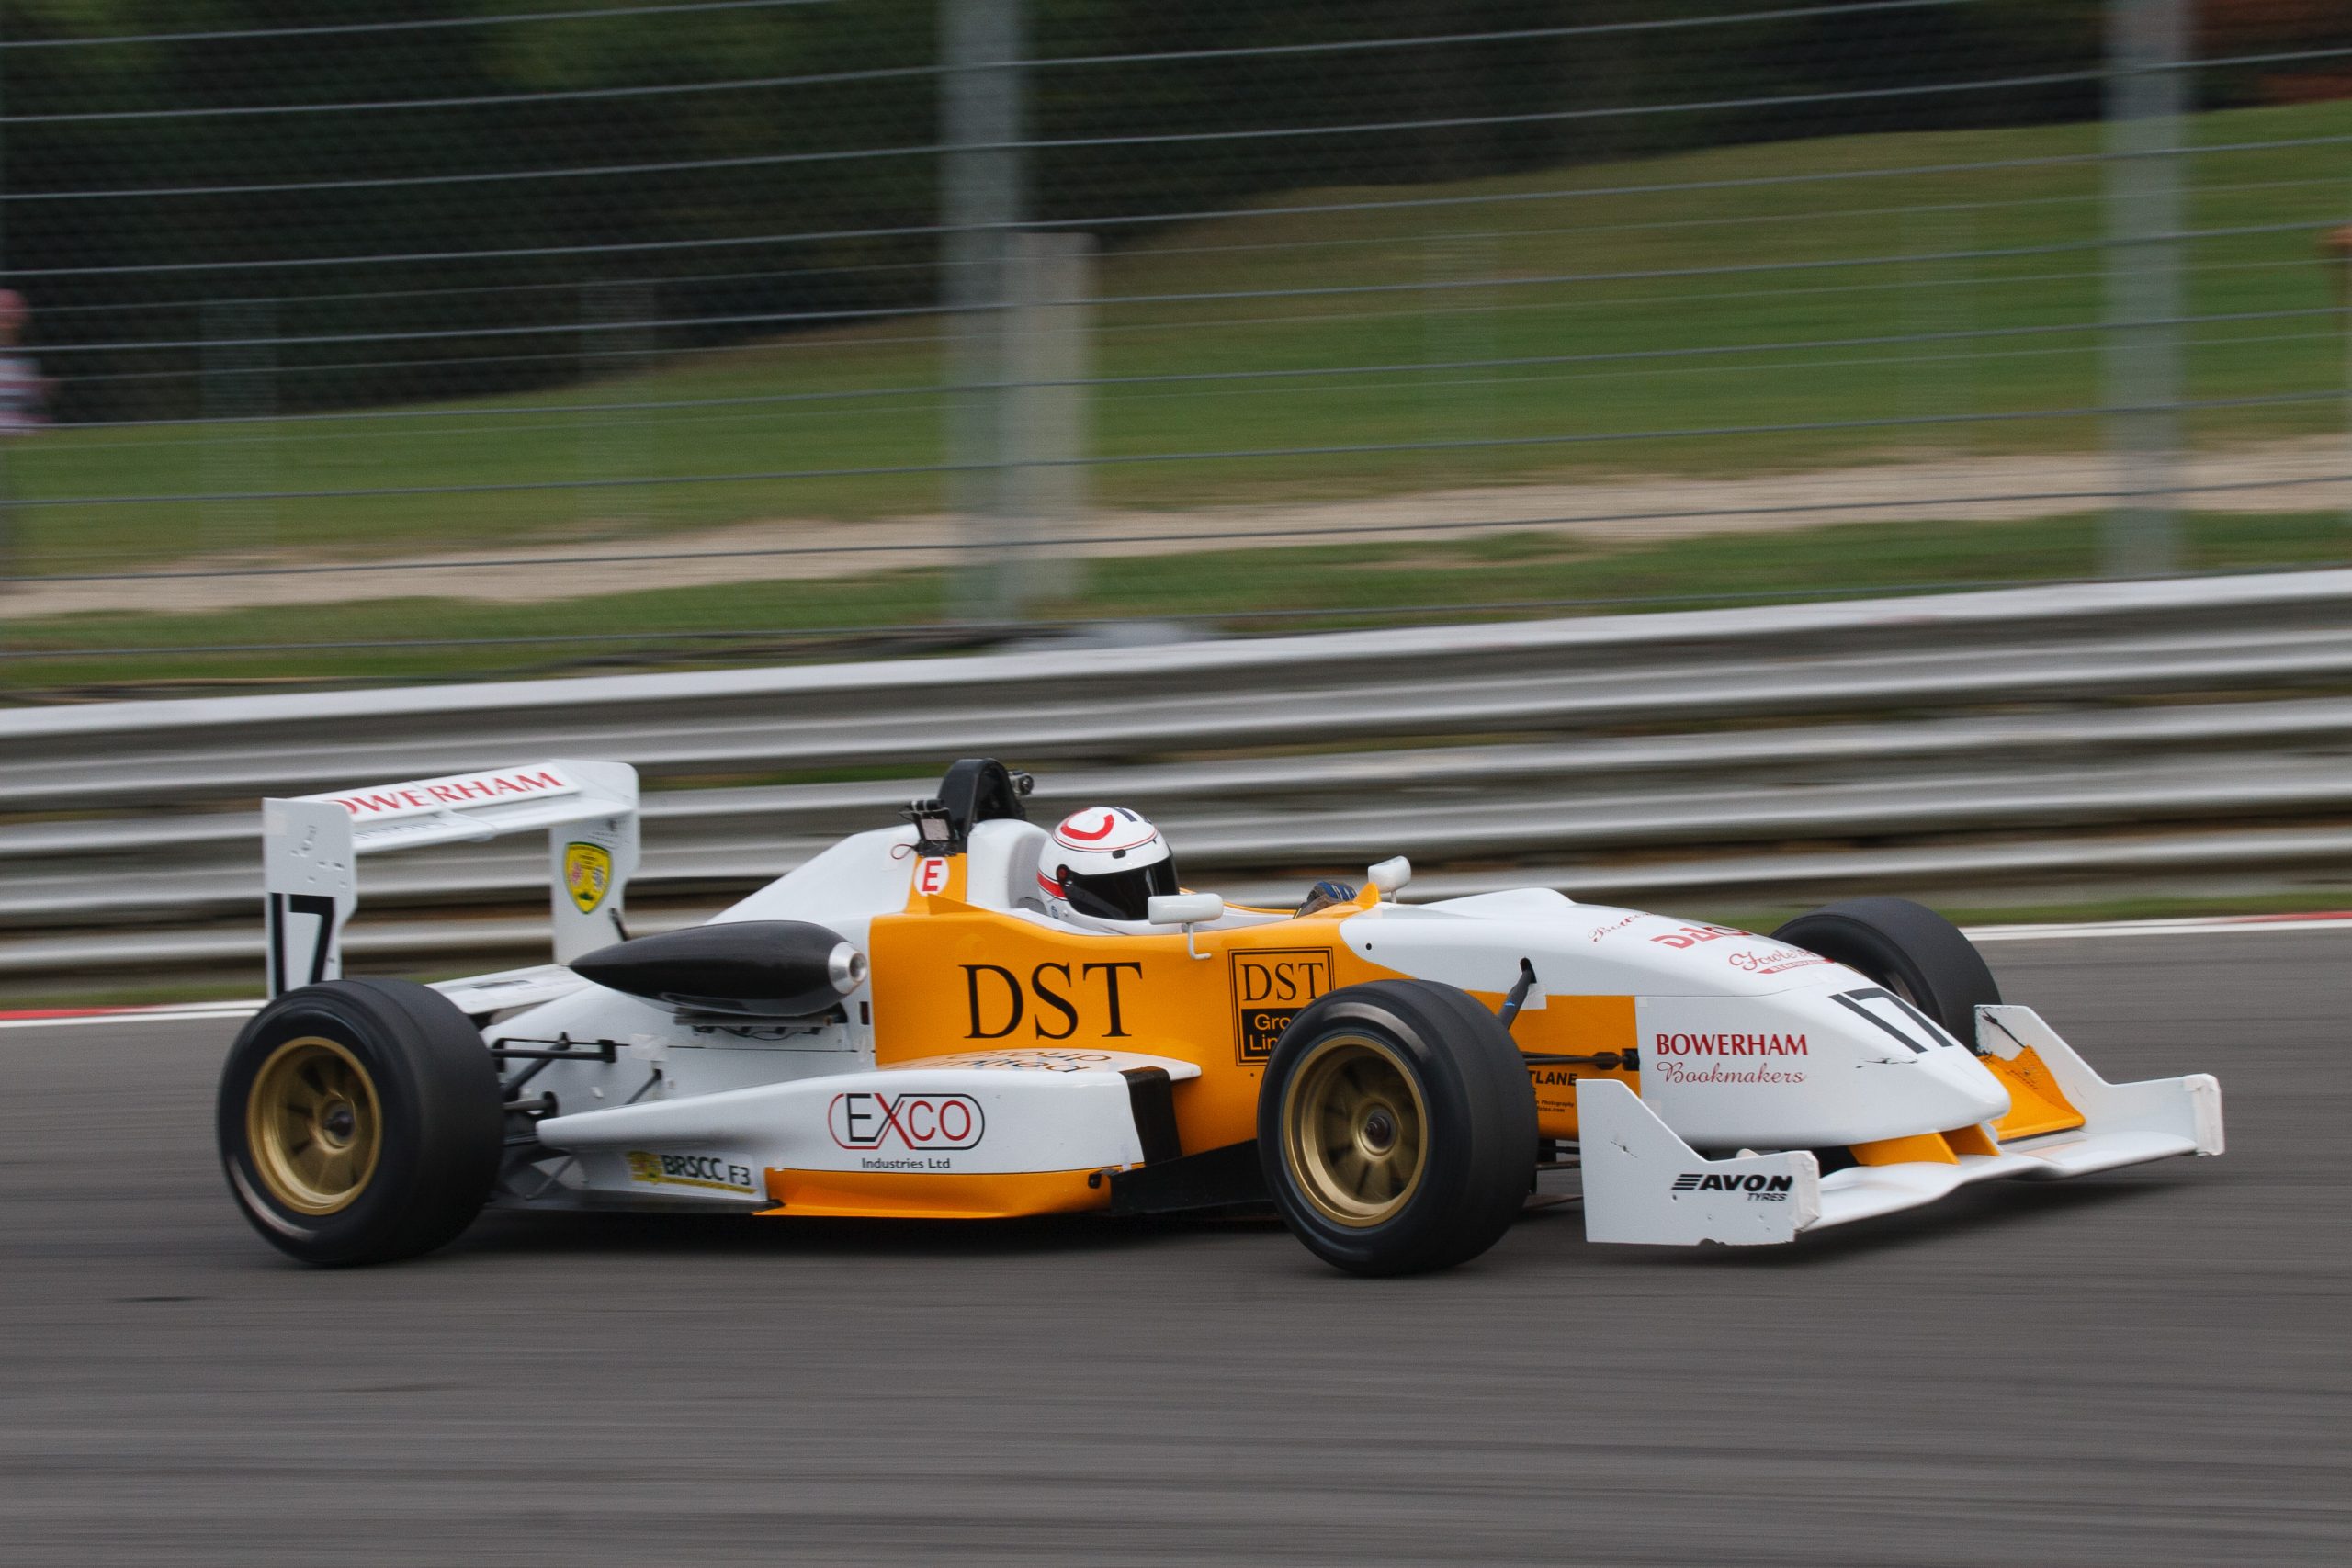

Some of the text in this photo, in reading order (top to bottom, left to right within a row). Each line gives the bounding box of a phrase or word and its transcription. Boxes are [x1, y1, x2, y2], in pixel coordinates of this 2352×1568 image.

[325, 771, 565, 815] OWERHAM
[922, 860, 942, 891] E
[270, 892, 335, 995] 17
[1239, 963, 1324, 1001] DST
[959, 962, 1143, 1040] DST
[1254, 1013, 1292, 1030] Gro
[1827, 987, 1955, 1055] 17
[946, 1051, 1112, 1062] Group
[1656, 1033, 1809, 1055] BOWERHAM
[1656, 1060, 1808, 1084] Bookmakers
[846, 1092, 972, 1150] EXCO
[660, 1154, 725, 1181] BRSCC
[728, 1164, 752, 1186] F3
[862, 1157, 951, 1169] Industries Ltd
[1699, 1174, 1793, 1192] AVON
[1747, 1192, 1787, 1201] TYRES
